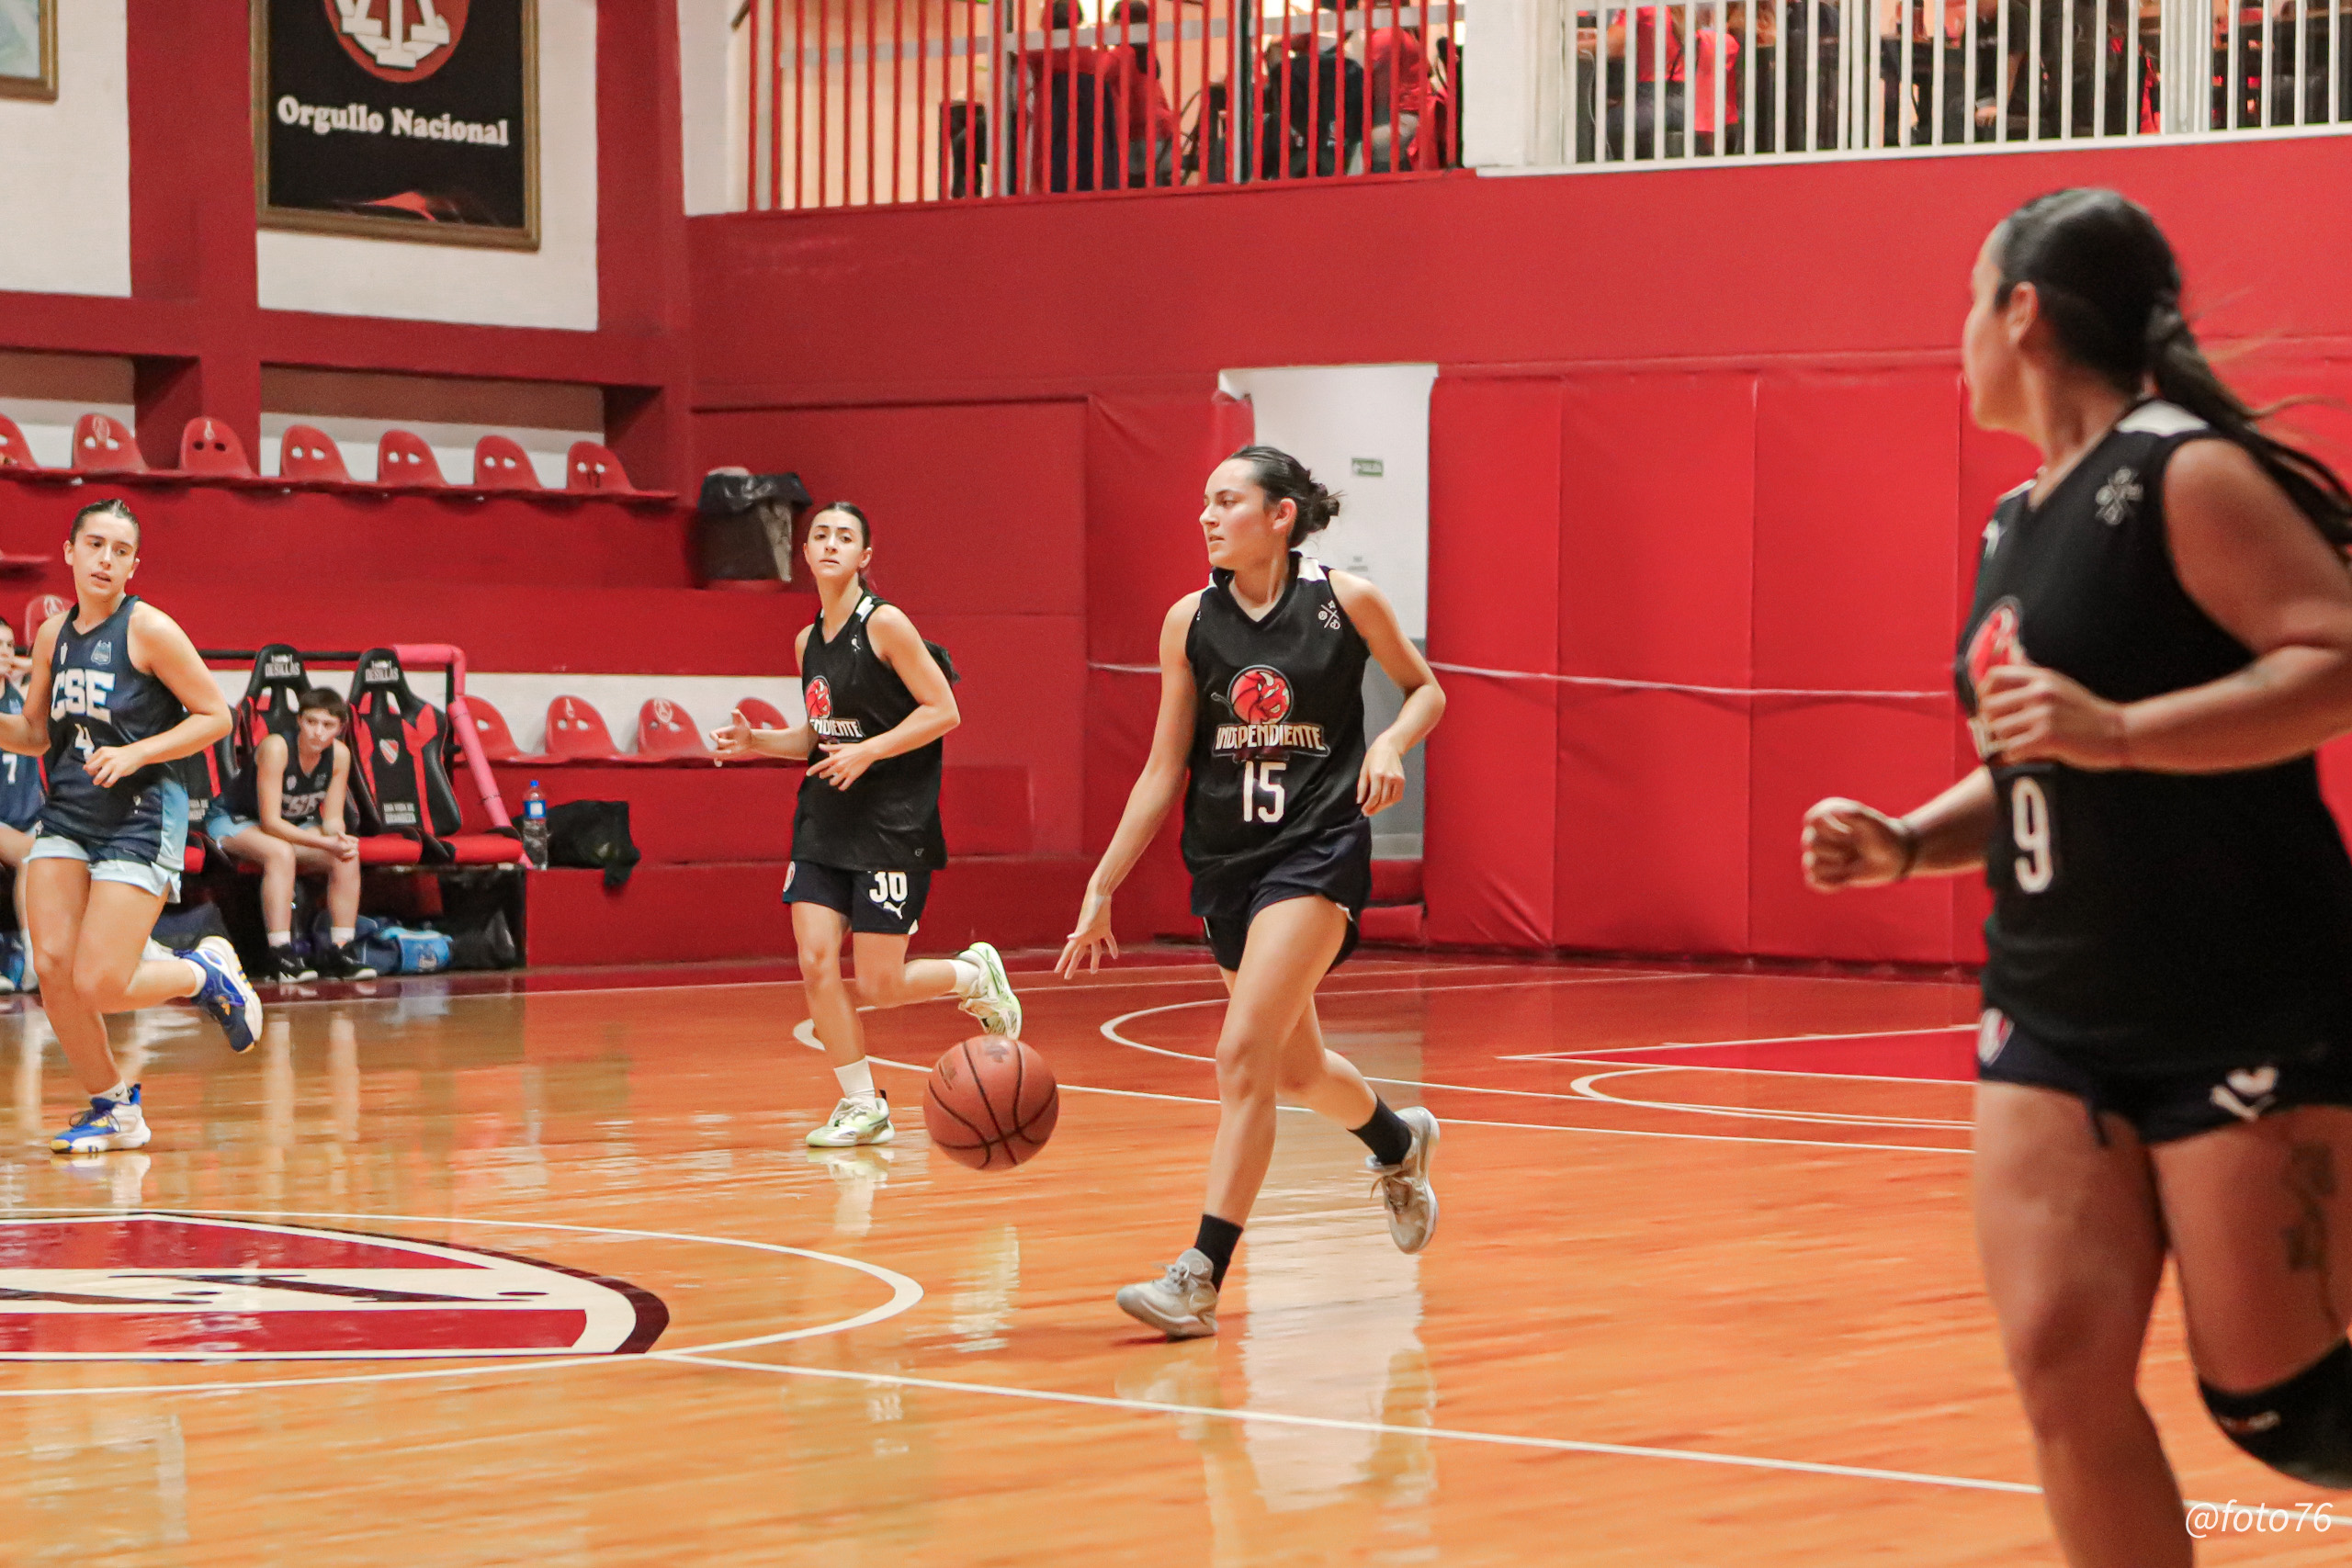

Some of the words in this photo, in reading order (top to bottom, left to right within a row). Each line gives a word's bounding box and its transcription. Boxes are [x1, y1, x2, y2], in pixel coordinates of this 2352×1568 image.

[277, 95, 384, 135] Orgullo
[390, 107, 509, 146] Nacional
[51, 668, 115, 724] CSE
[74, 723, 95, 761] 4
[2, 752, 17, 784] 7
[1243, 760, 1286, 823] 15
[2011, 776, 2053, 894] 9
[868, 871, 909, 903] 30
